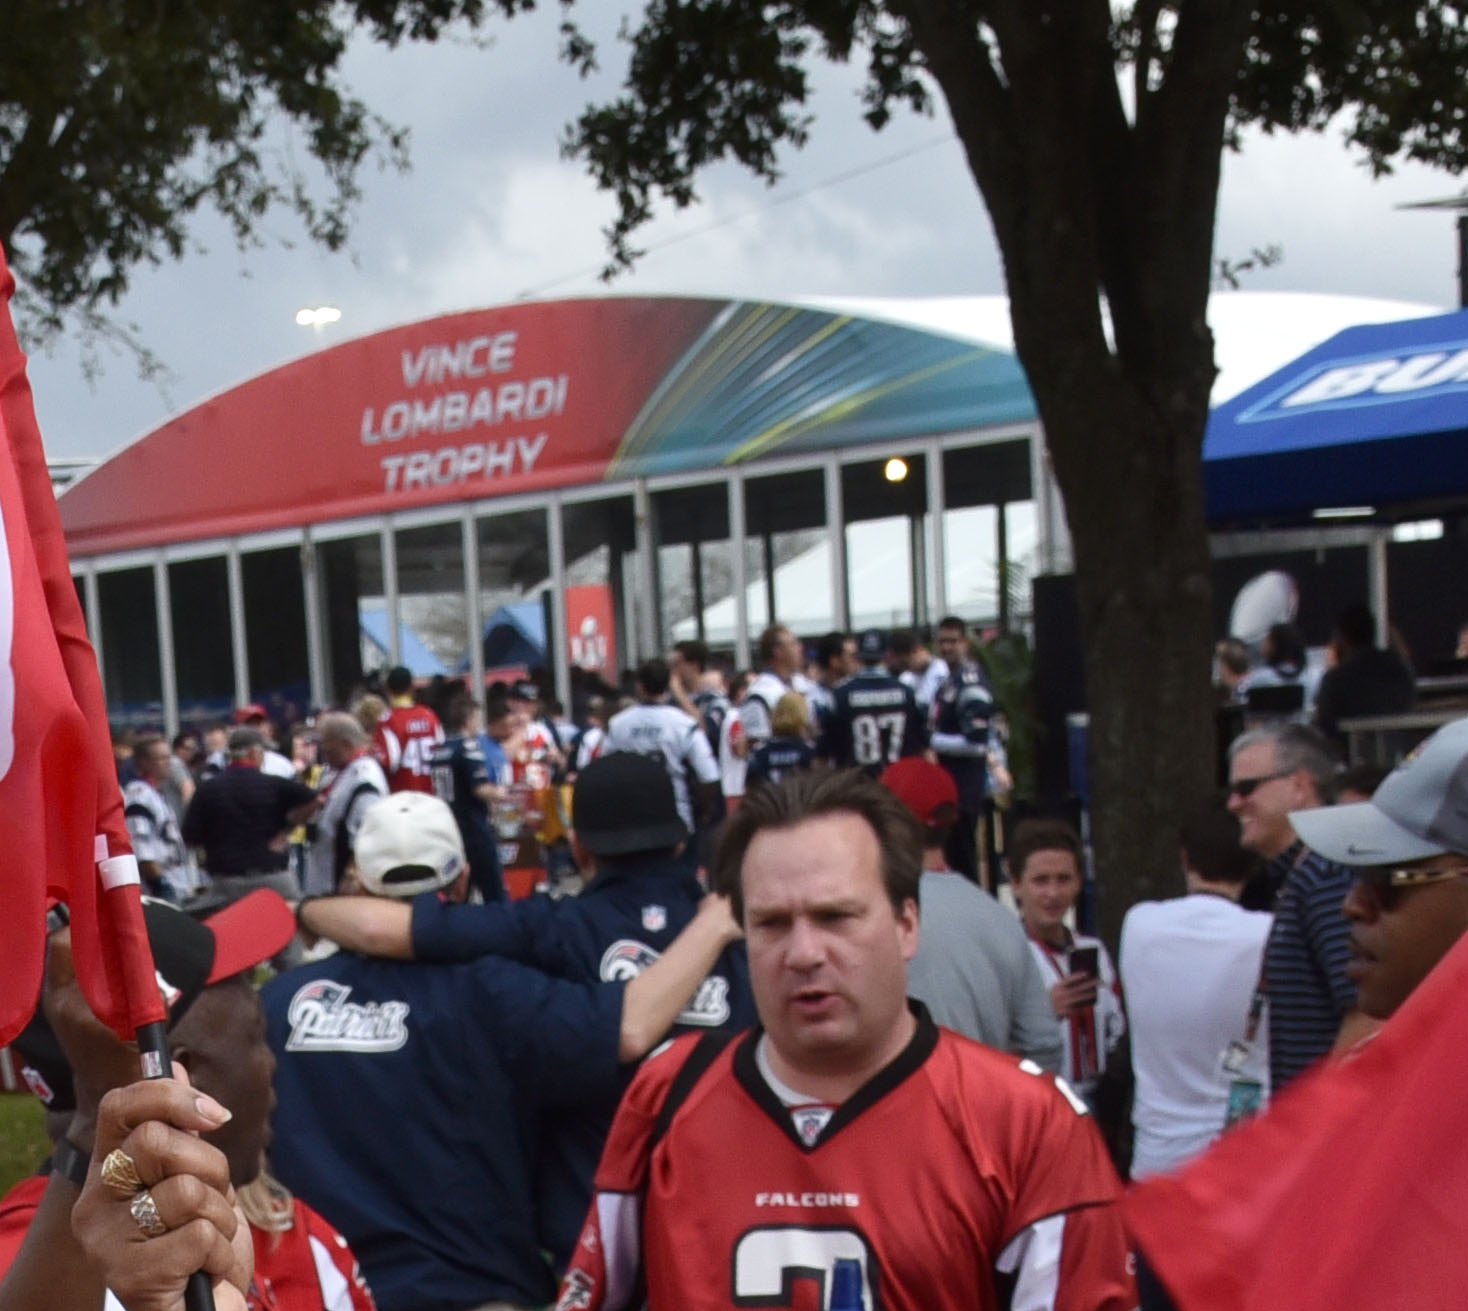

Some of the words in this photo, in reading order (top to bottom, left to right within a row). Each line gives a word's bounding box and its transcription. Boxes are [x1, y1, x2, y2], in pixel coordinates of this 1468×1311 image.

[400, 331, 519, 388] VINCE
[361, 373, 569, 445] LOMBARDI
[381, 432, 549, 493] TROPHY
[851, 712, 908, 764] 87
[754, 1191, 861, 1208] FALCONS
